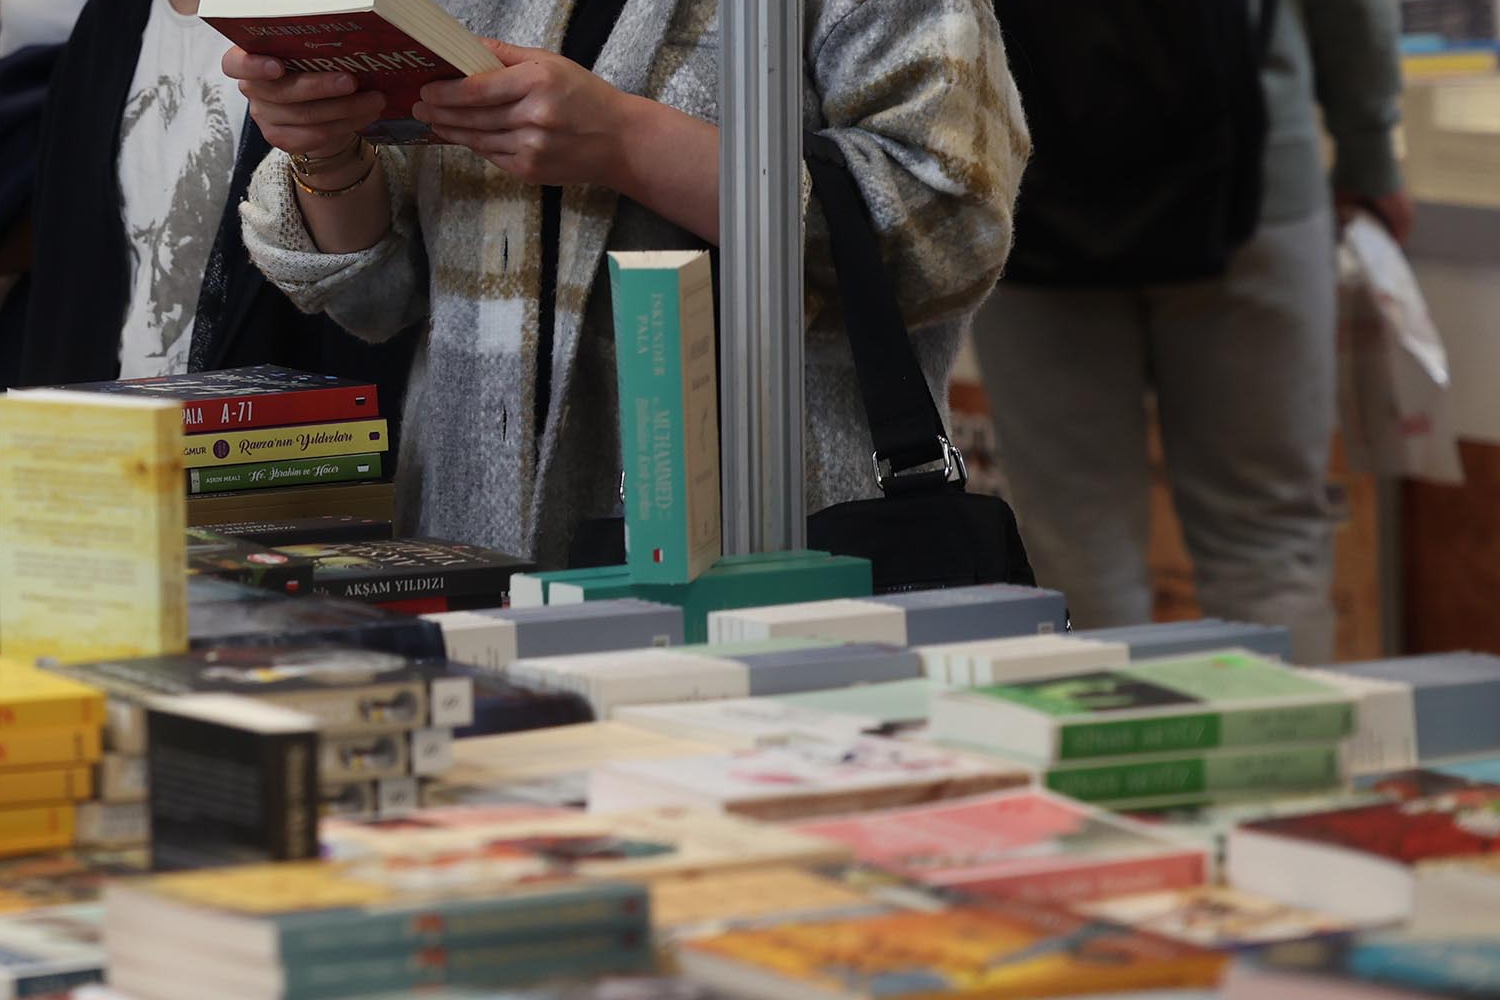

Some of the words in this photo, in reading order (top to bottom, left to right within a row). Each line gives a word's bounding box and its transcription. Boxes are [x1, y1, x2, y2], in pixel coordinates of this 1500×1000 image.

[244, 21, 319, 37] İSKENDER
[320, 20, 362, 32] PALA
[221, 401, 253, 423] A-71
[239, 437, 293, 455] Ravza'nın
[296, 431, 353, 451] Yıldızları
[345, 581, 391, 598] AKŞAM
[395, 576, 445, 592] YILDIZI
